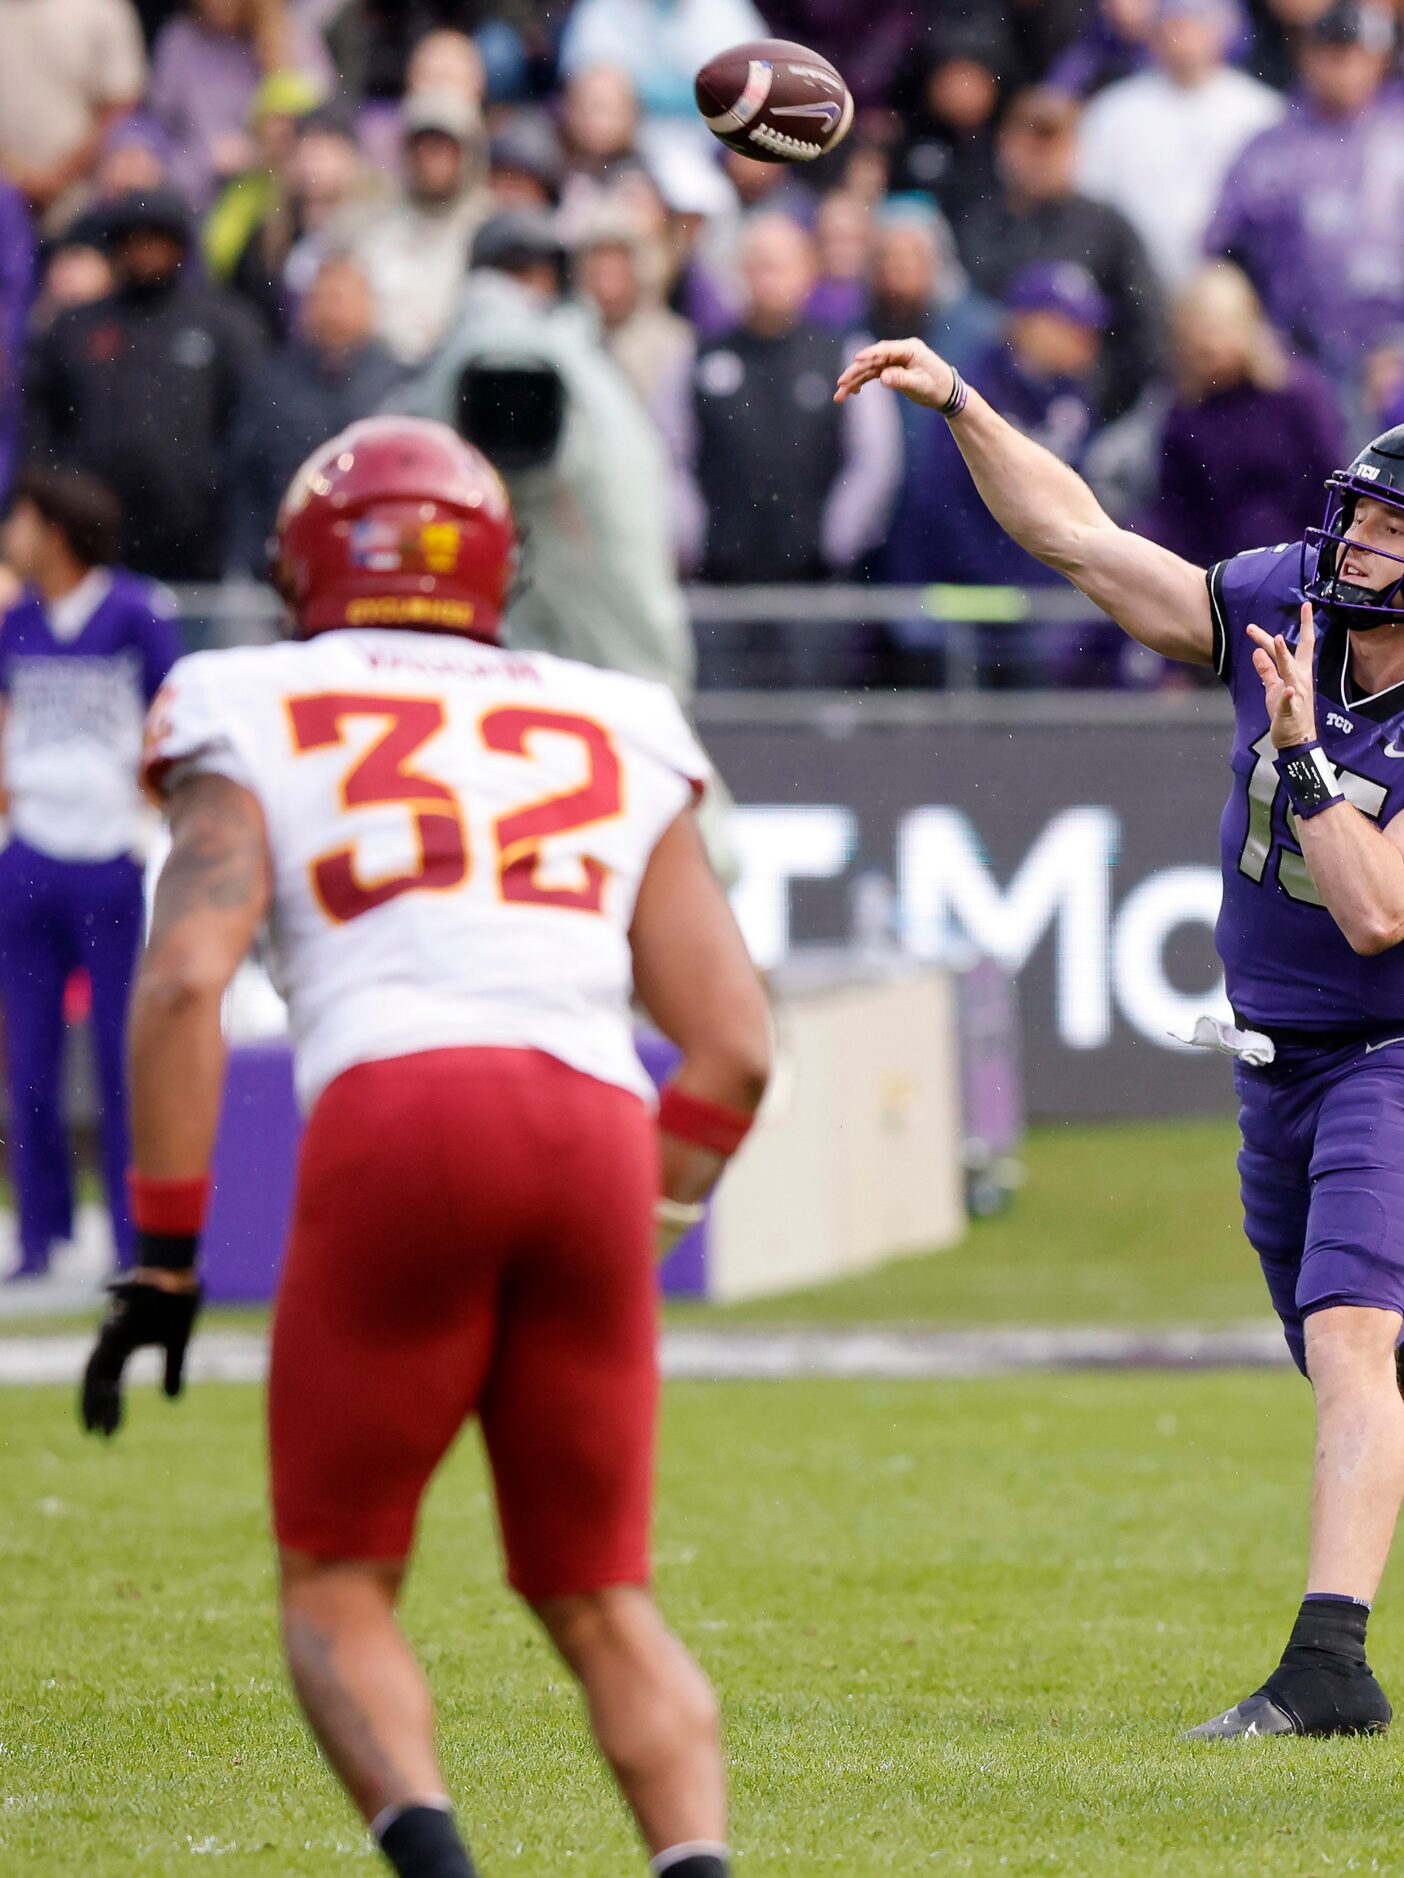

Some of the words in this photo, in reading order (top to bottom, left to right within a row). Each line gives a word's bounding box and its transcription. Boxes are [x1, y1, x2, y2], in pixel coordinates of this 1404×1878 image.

[1356, 463, 1381, 480] TCU
[1326, 712, 1354, 735] TCU
[284, 692, 626, 927] 32
